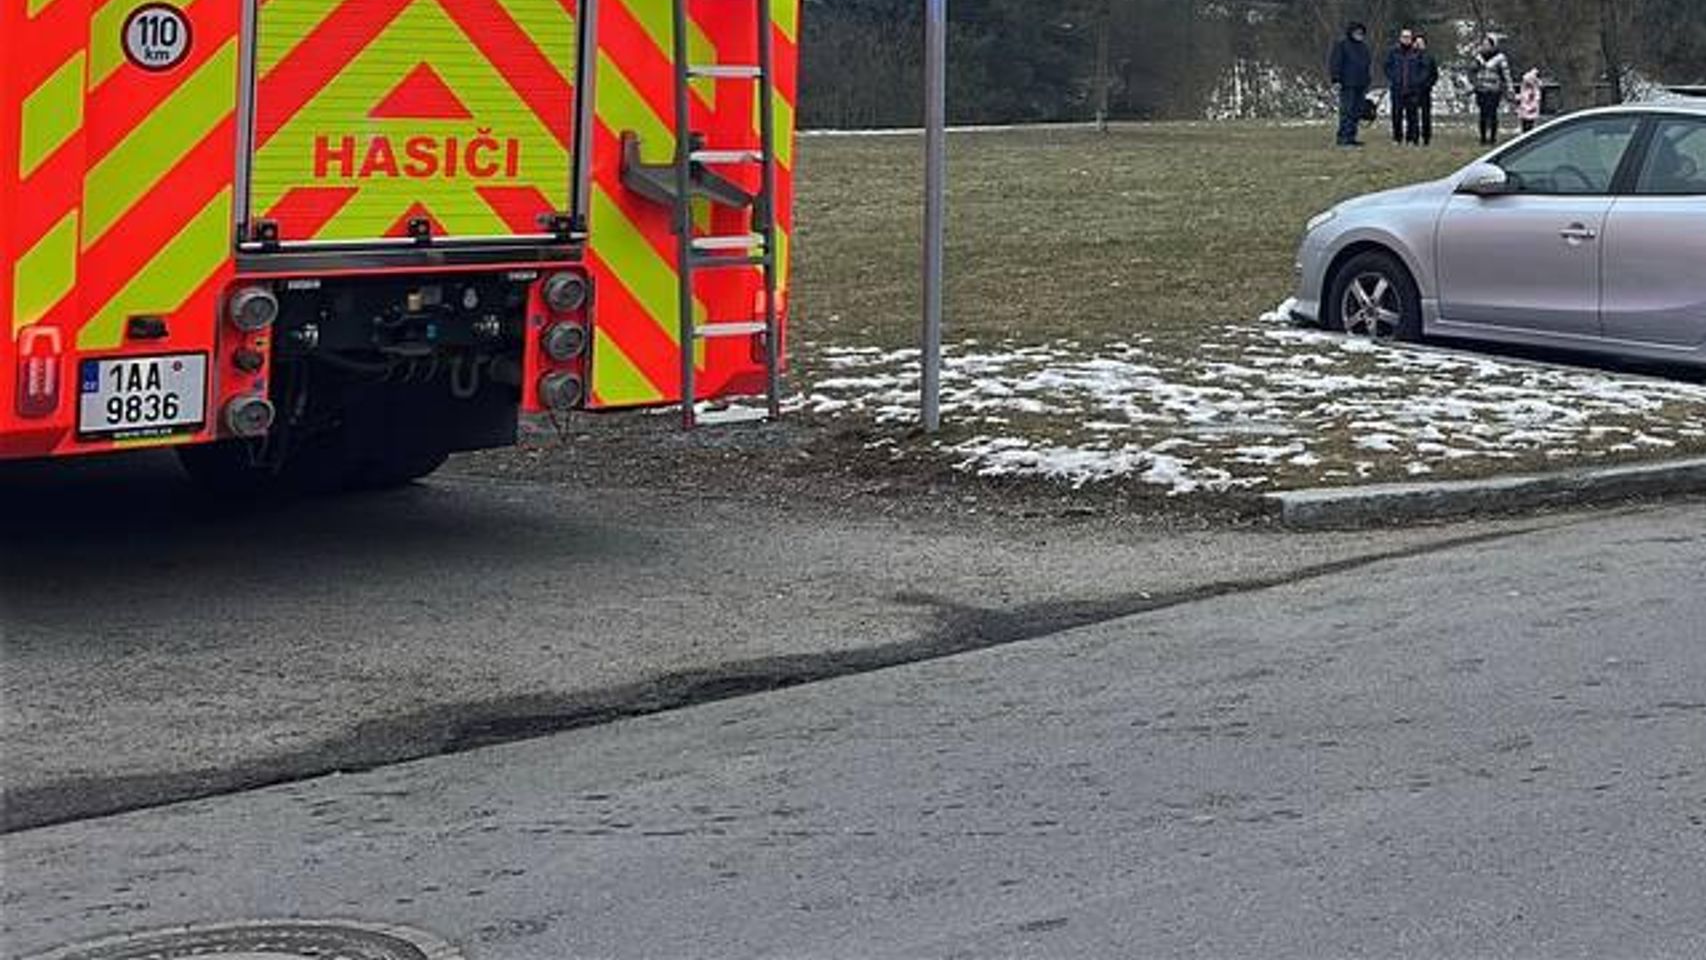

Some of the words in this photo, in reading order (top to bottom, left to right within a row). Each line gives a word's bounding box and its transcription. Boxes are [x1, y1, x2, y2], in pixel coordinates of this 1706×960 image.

[137, 16, 178, 47] 110
[144, 48, 170, 61] km
[314, 127, 520, 178] HASIČI
[109, 363, 162, 392] 1AA
[106, 392, 180, 425] 9836
